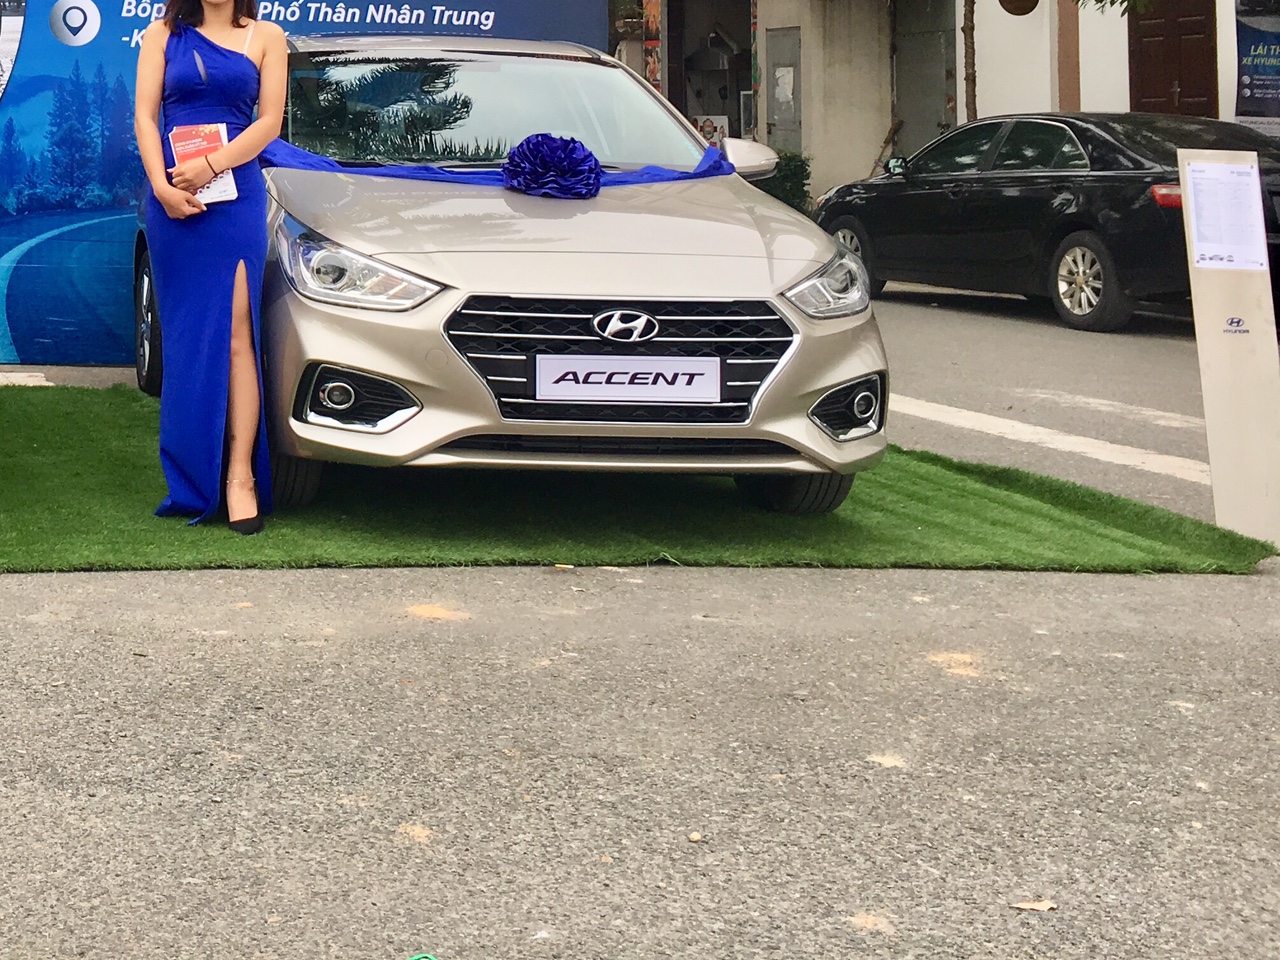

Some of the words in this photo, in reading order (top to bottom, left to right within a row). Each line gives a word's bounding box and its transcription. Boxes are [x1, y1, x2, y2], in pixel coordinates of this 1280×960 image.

[257, 0, 305, 21] Phố
[306, 1, 361, 23] Thân
[365, 3, 426, 25] Nhân
[431, 5, 495, 30] Trung
[551, 371, 706, 386] ACCENT
